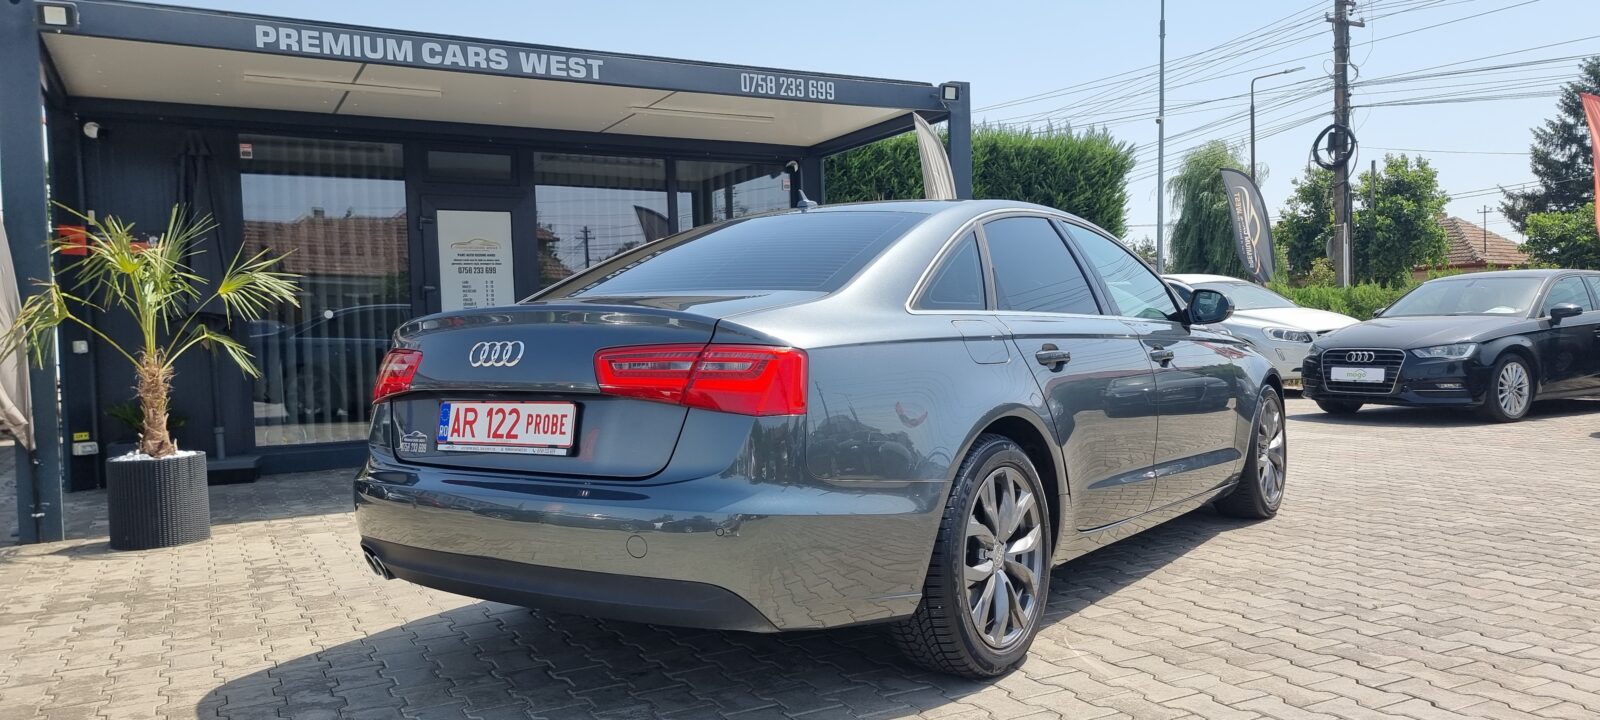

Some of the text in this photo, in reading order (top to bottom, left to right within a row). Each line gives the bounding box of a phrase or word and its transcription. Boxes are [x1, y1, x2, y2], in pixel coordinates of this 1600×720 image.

[255, 25, 604, 80] PREMIUM CARS WEST
[740, 73, 835, 100] 0758 233 699
[439, 425, 448, 437] RO
[451, 407, 568, 439] AR 122 PROBE
